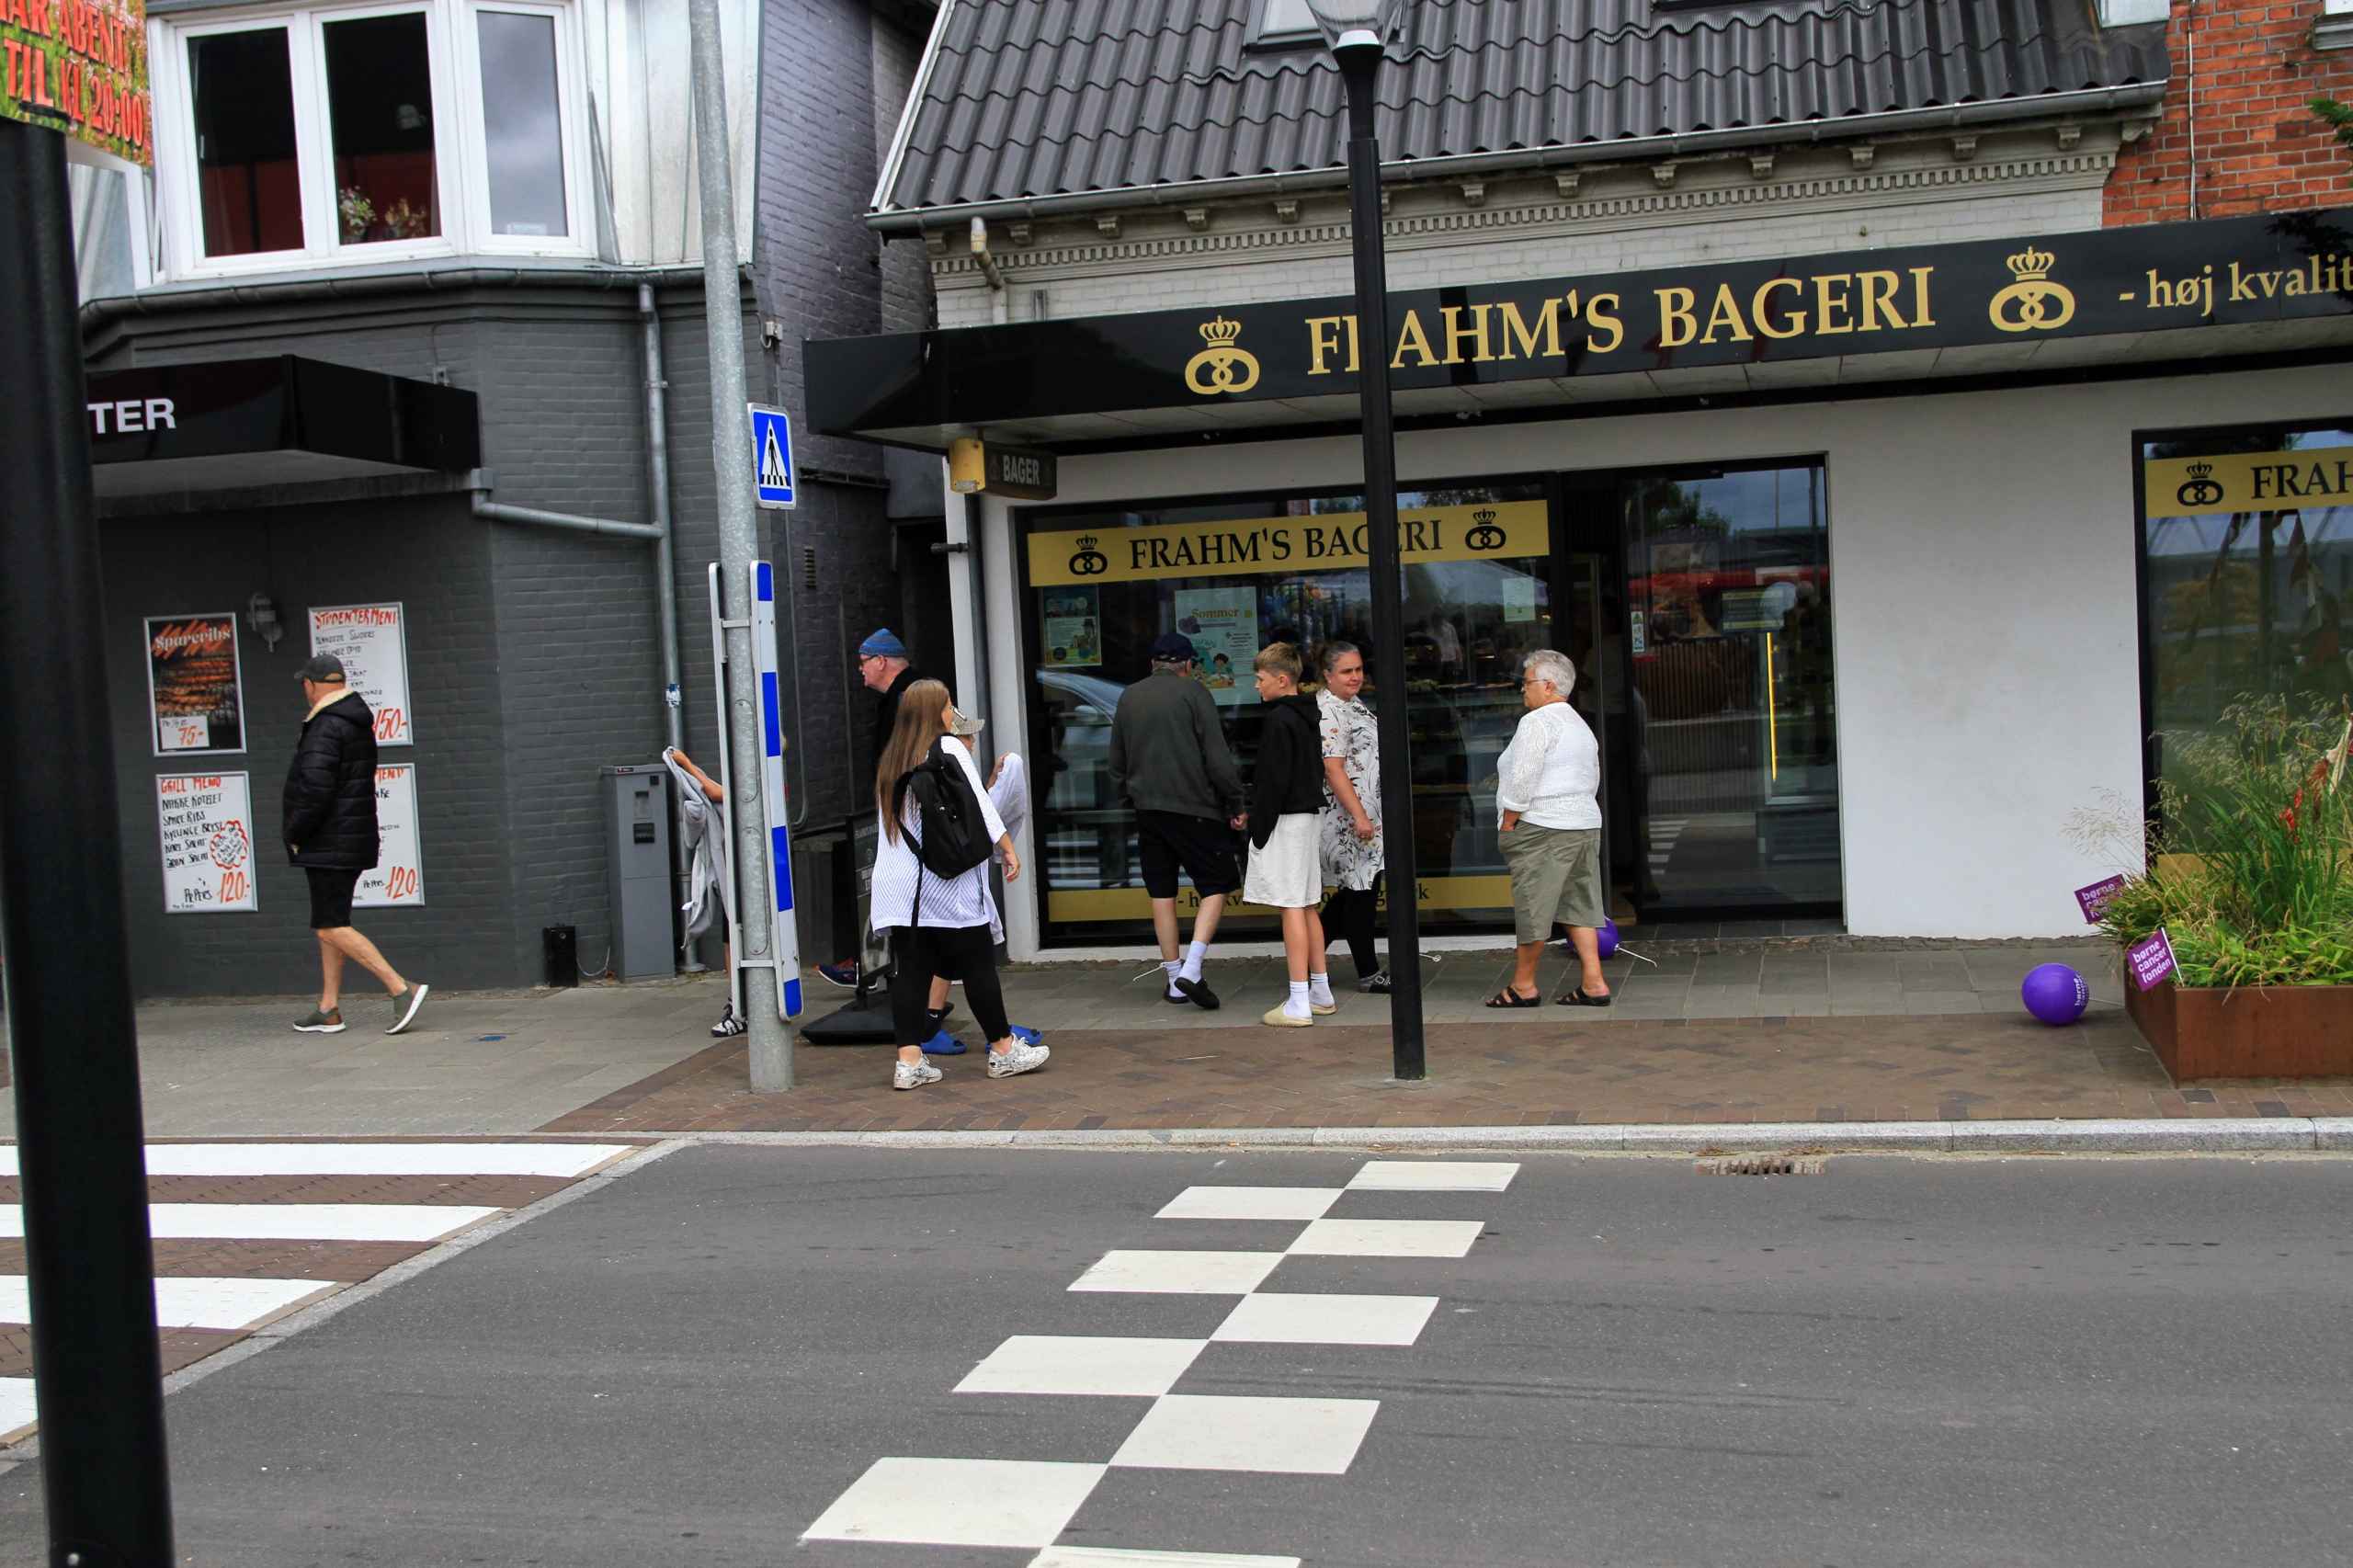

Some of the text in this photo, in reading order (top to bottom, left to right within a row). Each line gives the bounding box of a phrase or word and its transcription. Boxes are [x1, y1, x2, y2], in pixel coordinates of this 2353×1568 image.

[4, 37, 53, 108] TIL
[90, 74, 144, 147] 20:00
[2146, 265, 2213, 318] høj
[1654, 266, 1936, 347] BAGERI
[1003, 454, 1040, 485] BAGER
[1130, 528, 1292, 570] FRAHM'S
[1191, 608, 1239, 619] Sommer
[2082, 882, 2115, 902] børne
[2132, 940, 2160, 964] børne
[2137, 948, 2167, 972] cancer
[2142, 959, 2171, 983] fonden
